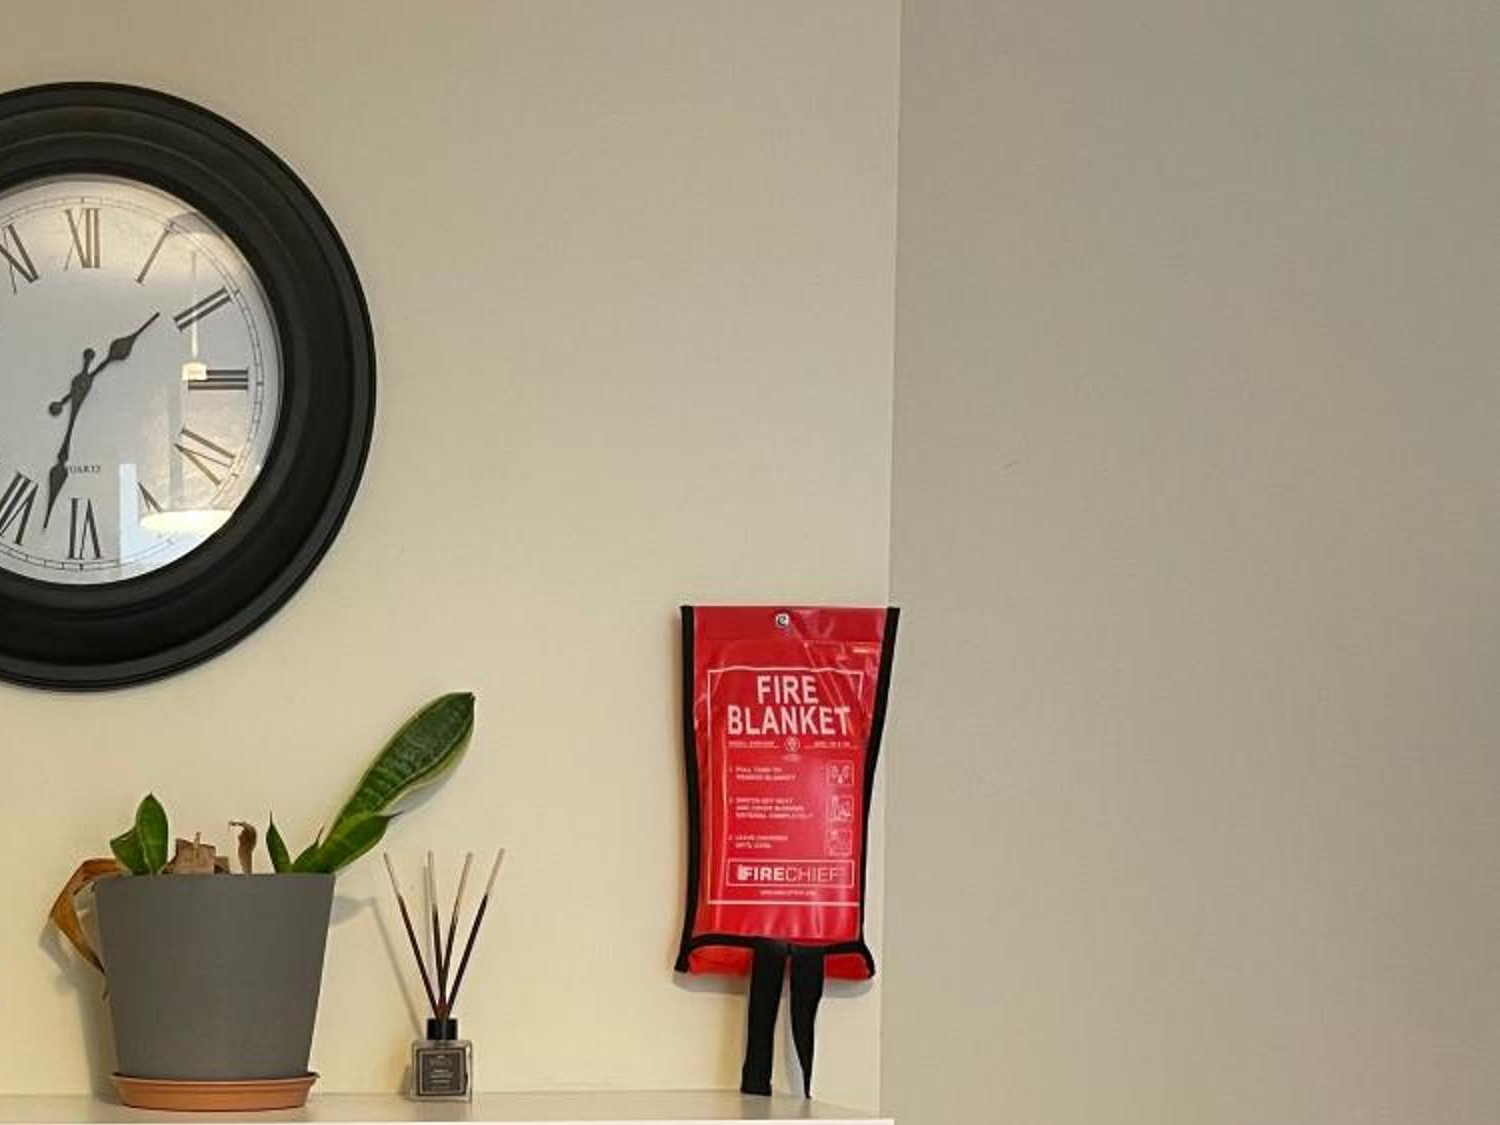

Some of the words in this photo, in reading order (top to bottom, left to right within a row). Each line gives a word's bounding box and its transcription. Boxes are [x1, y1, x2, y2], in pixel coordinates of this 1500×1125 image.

[64, 208, 100, 272] XII
[172, 286, 232, 332] II
[187, 368, 248, 391] III
[68, 464, 101, 474] UARTZ
[68, 498, 101, 560] VI
[756, 675, 819, 705] FIRE
[726, 704, 851, 736] BLANKET
[745, 866, 839, 882] FIRECHIEF
